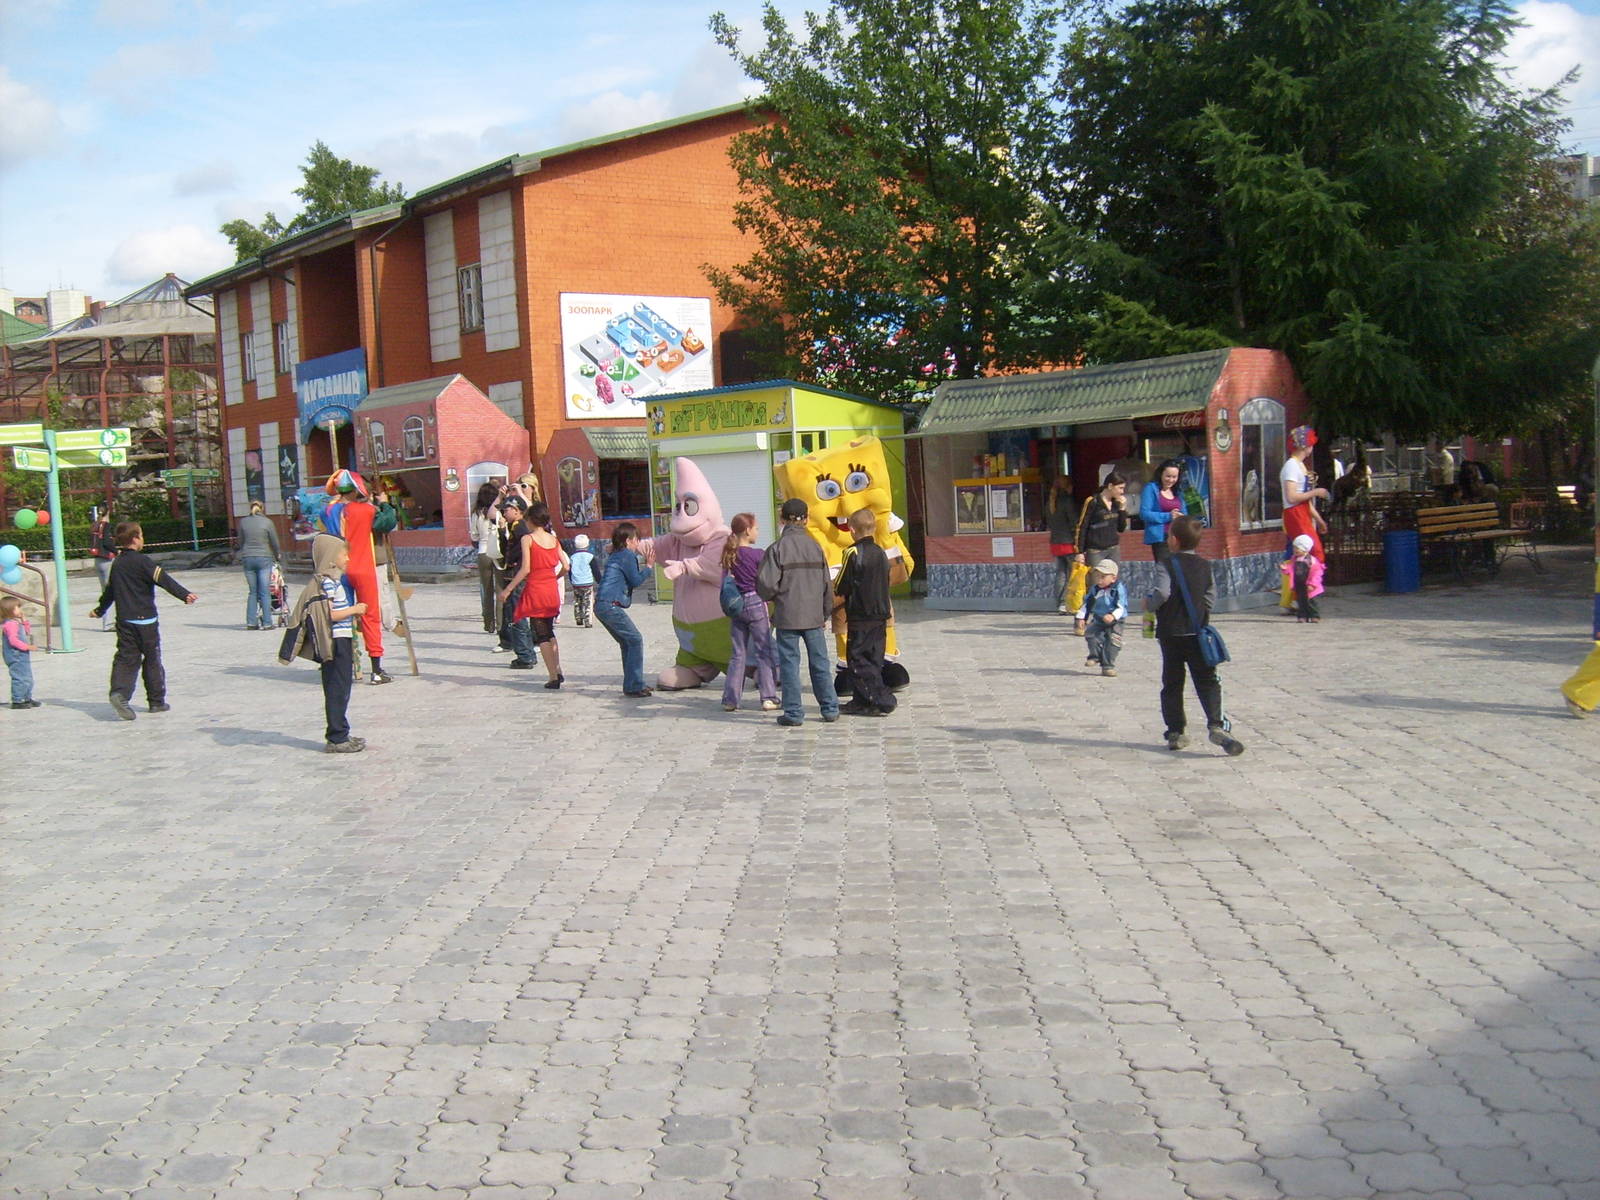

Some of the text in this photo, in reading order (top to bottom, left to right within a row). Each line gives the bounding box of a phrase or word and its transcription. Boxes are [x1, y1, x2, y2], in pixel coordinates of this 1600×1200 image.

[568, 305, 613, 315] ЗООПАРК
[303, 370, 361, 404] АКВАМИР
[670, 400, 767, 433] ИГРУШКИ
